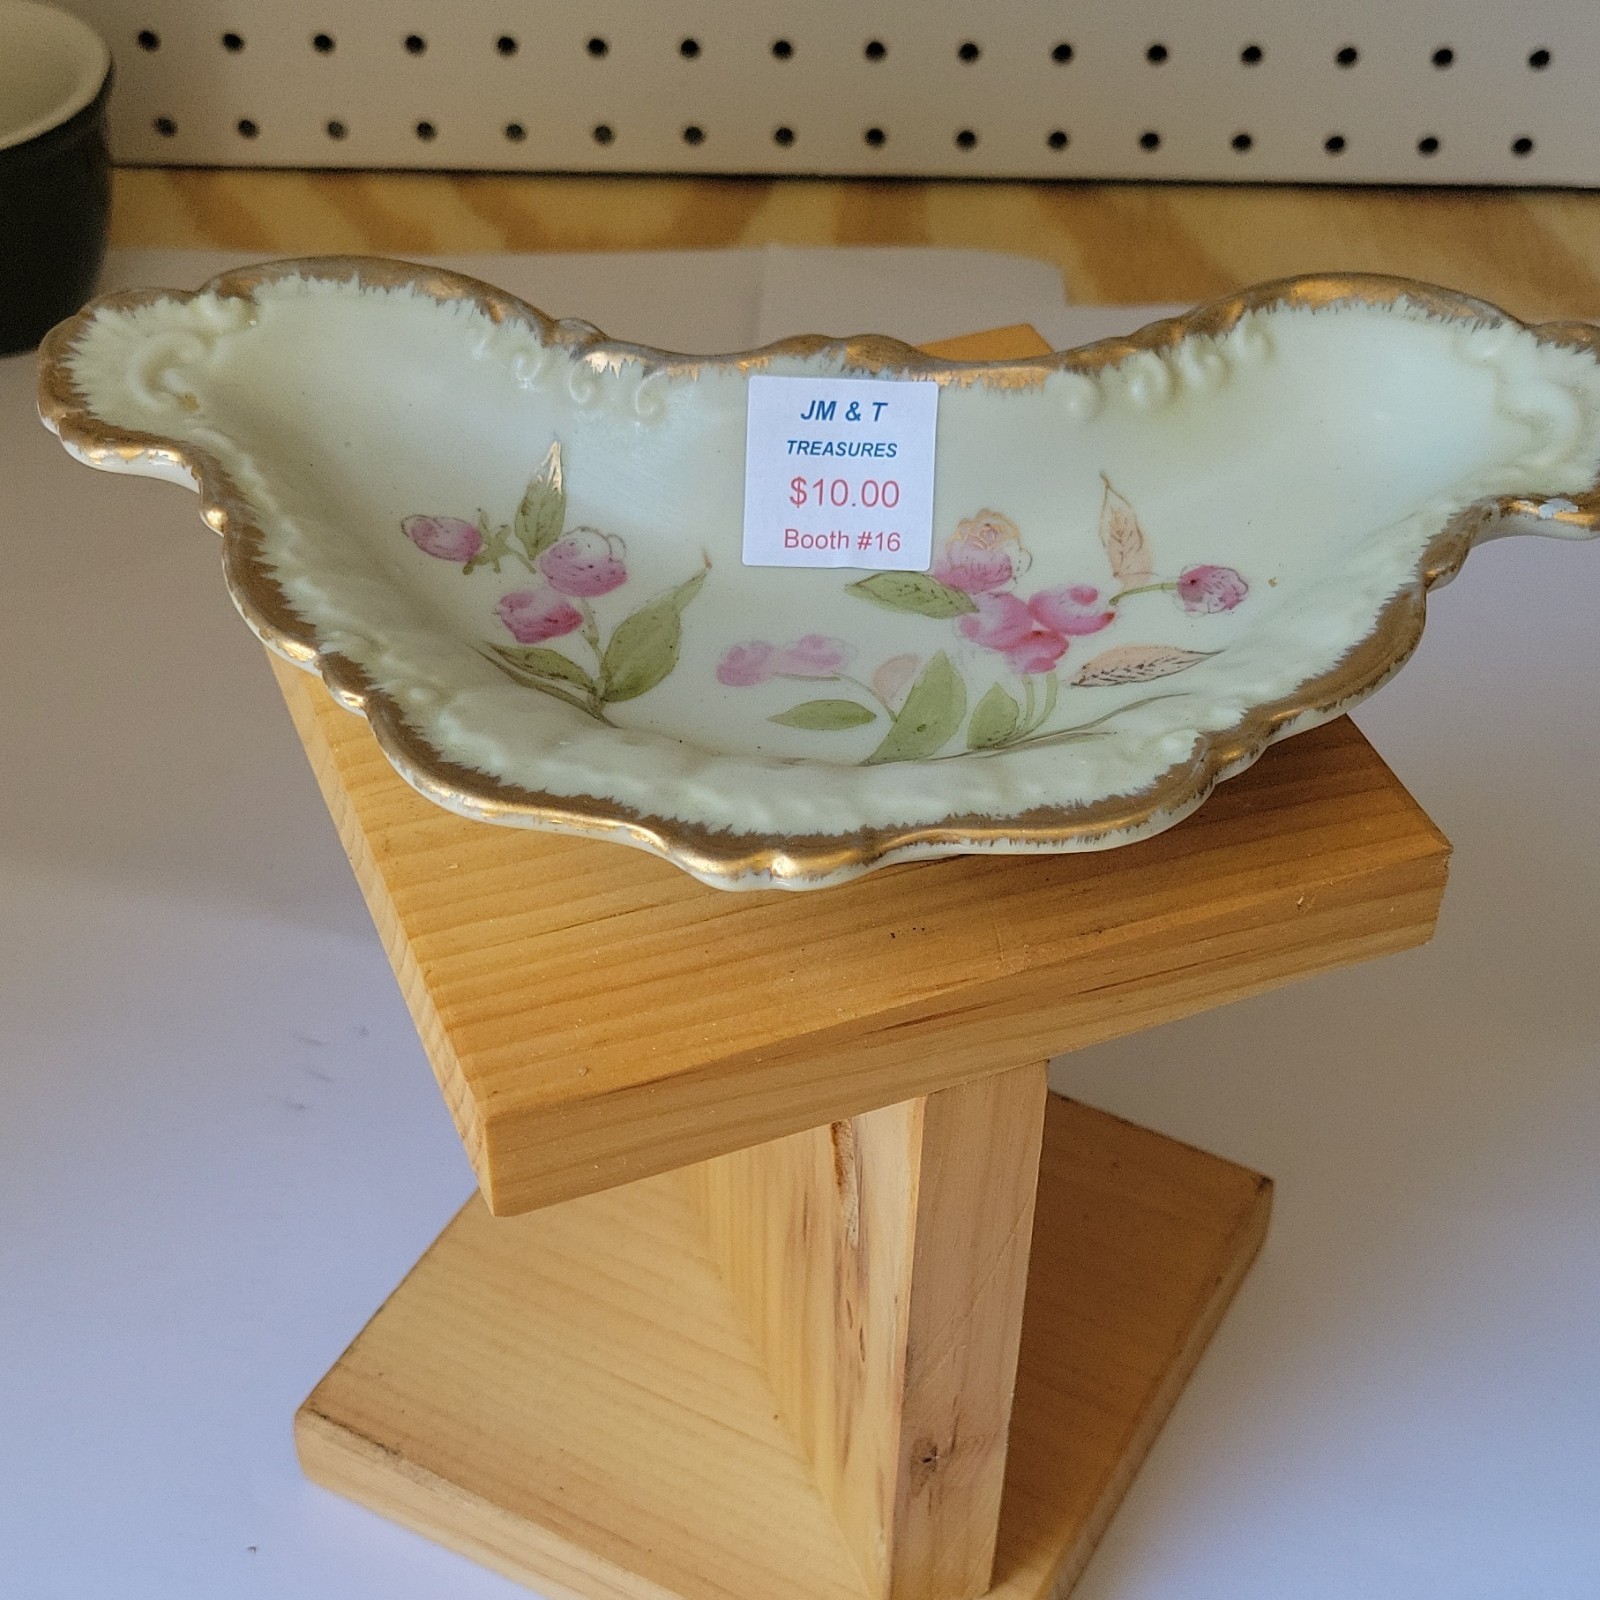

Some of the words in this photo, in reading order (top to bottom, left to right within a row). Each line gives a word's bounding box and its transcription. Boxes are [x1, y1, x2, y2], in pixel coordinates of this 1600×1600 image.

[800, 400, 838, 422] JM
[845, 401, 862, 422] &
[872, 402, 889, 422] T
[786, 439, 898, 458] TREASURES
[789, 475, 900, 509] $10.00
[784, 528, 850, 550] Booth
[857, 531, 901, 552] #16
